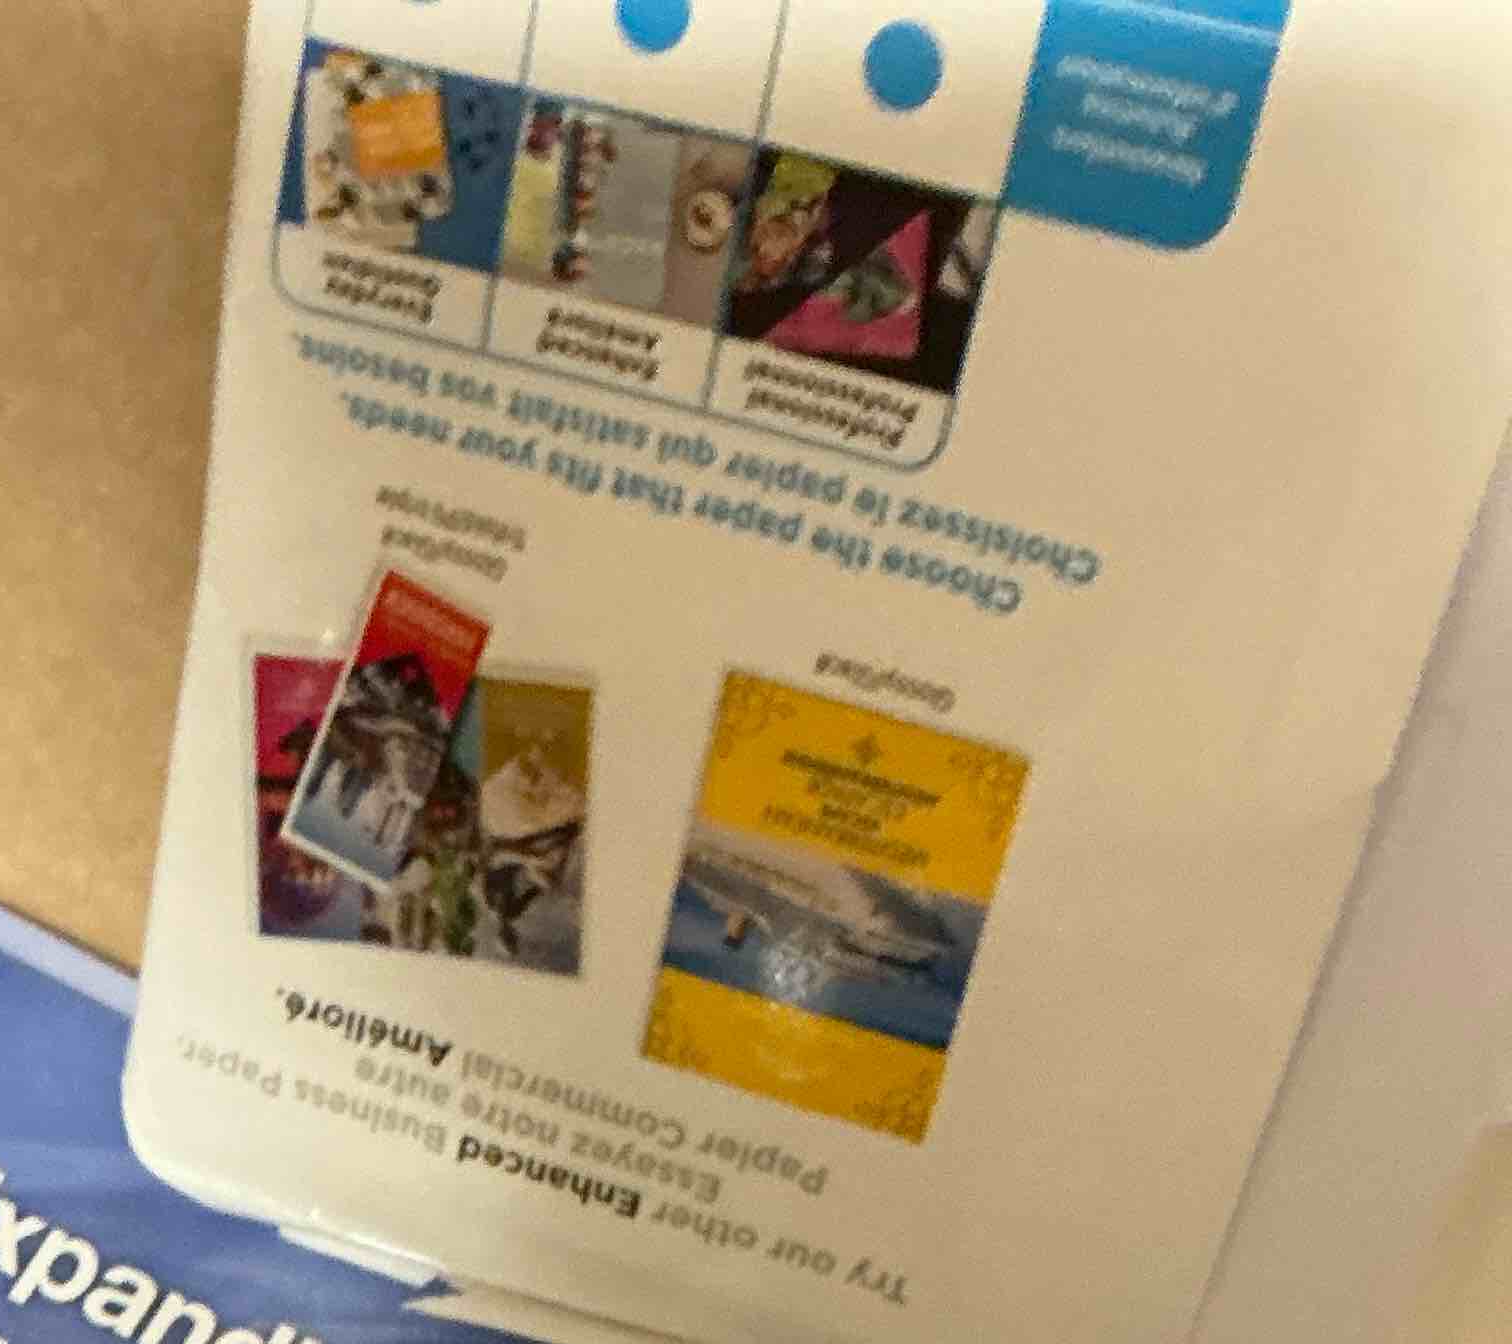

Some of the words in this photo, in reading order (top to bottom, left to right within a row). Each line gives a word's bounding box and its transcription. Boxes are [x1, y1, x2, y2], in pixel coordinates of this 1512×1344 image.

[439, 369, 498, 406] vos
[507, 387, 650, 451] satisfait
[458, 424, 538, 470] your
[547, 449, 602, 496] fits
[657, 432, 718, 470] qui
[612, 466, 685, 518] that
[725, 451, 849, 506] papier
[693, 492, 804, 546] paper
[854, 486, 890, 526] le
[810, 525, 873, 573] the
[898, 498, 1102, 586] Choisissez
[879, 545, 1025, 615] Choose
[275, 986, 454, 1066] Amélioré.
[355, 1055, 451, 1107] autre
[462, 1051, 685, 1150] Commercial
[294, 1079, 448, 1155] Business
[460, 1092, 561, 1148] notre
[456, 1134, 642, 1220] Enhanced
[571, 1131, 722, 1204] Essayez
[696, 1131, 831, 1198] Papier
[650, 1202, 759, 1251] other
[766, 1236, 836, 1277] our
[845, 1257, 910, 1307] Try
